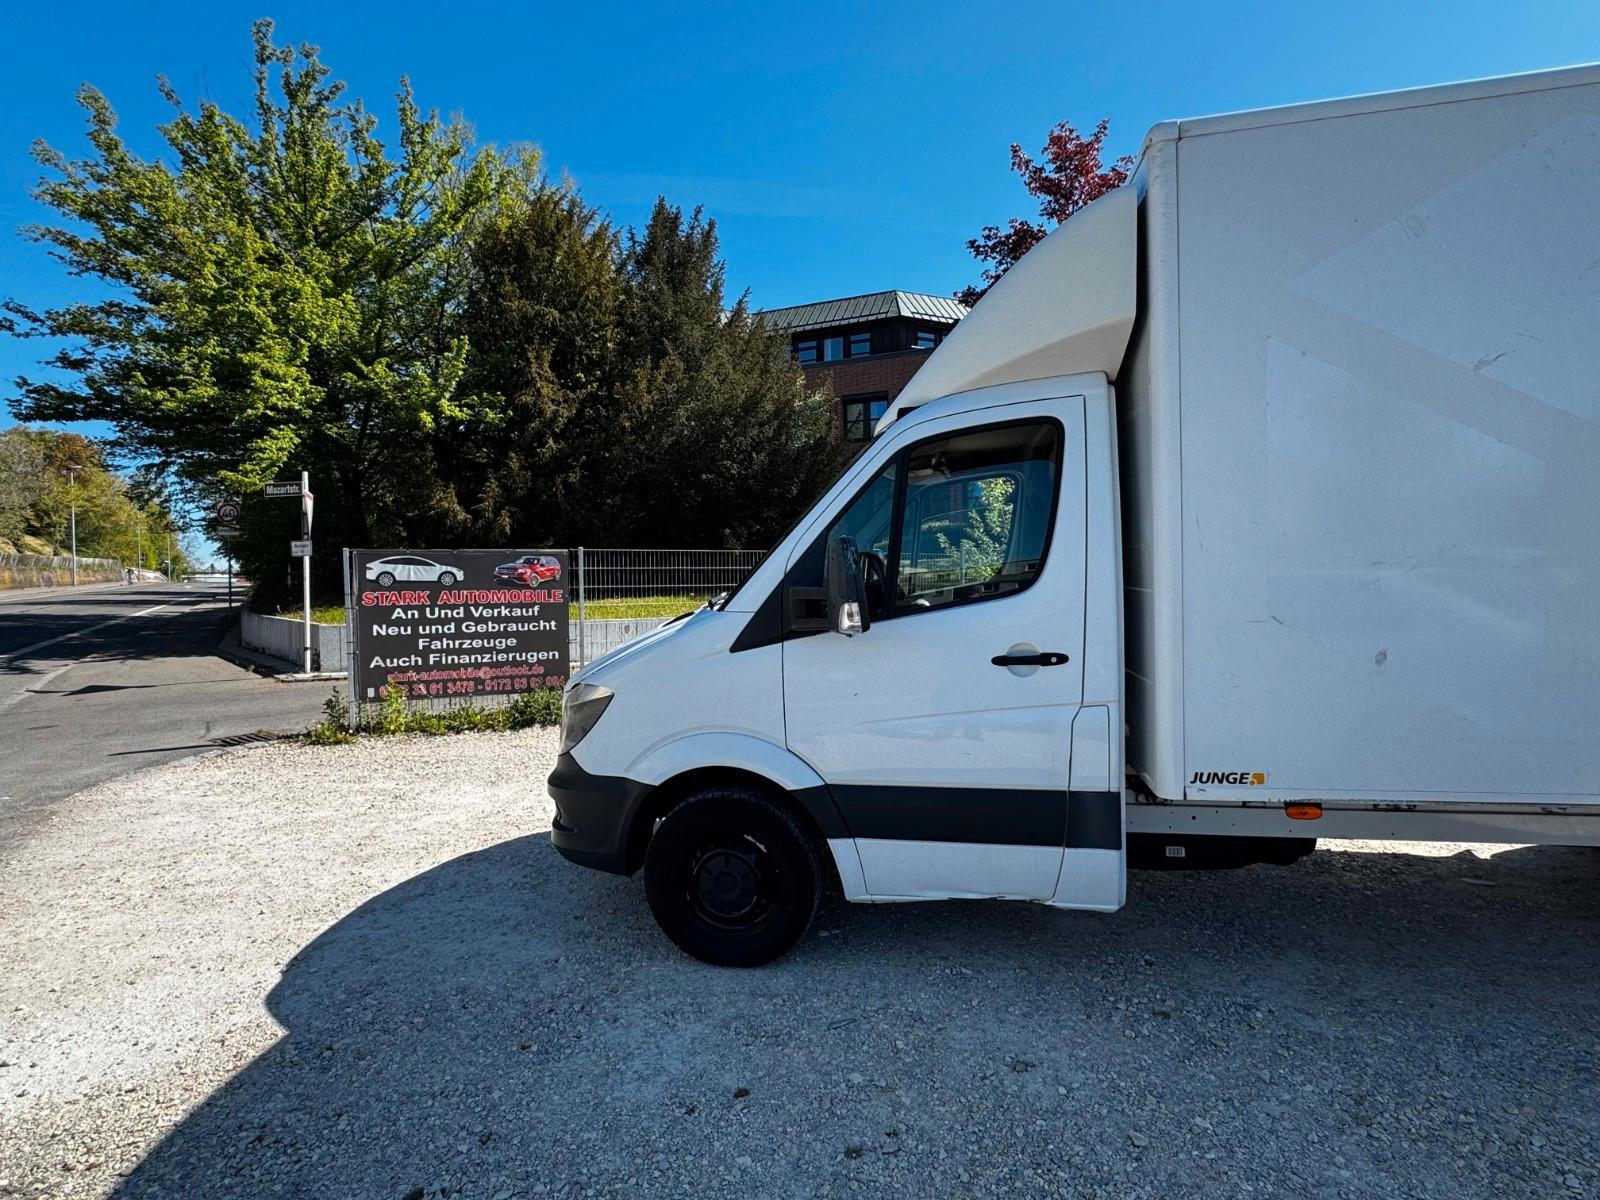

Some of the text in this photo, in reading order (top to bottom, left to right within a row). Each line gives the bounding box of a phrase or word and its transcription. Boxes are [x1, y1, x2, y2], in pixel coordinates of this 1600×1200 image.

[266, 484, 300, 495] Mozartstr.
[362, 589, 564, 606] STARK AUTOMOBILE
[391, 604, 540, 620] An Und Verkauf
[372, 619, 557, 636] Neu und Gebraucht
[418, 636, 518, 650] Fahrzeuge
[370, 650, 560, 669] Auch Finanzierugen
[485, 678, 512, 692] 0172
[1190, 772, 1250, 785] JUNGE
